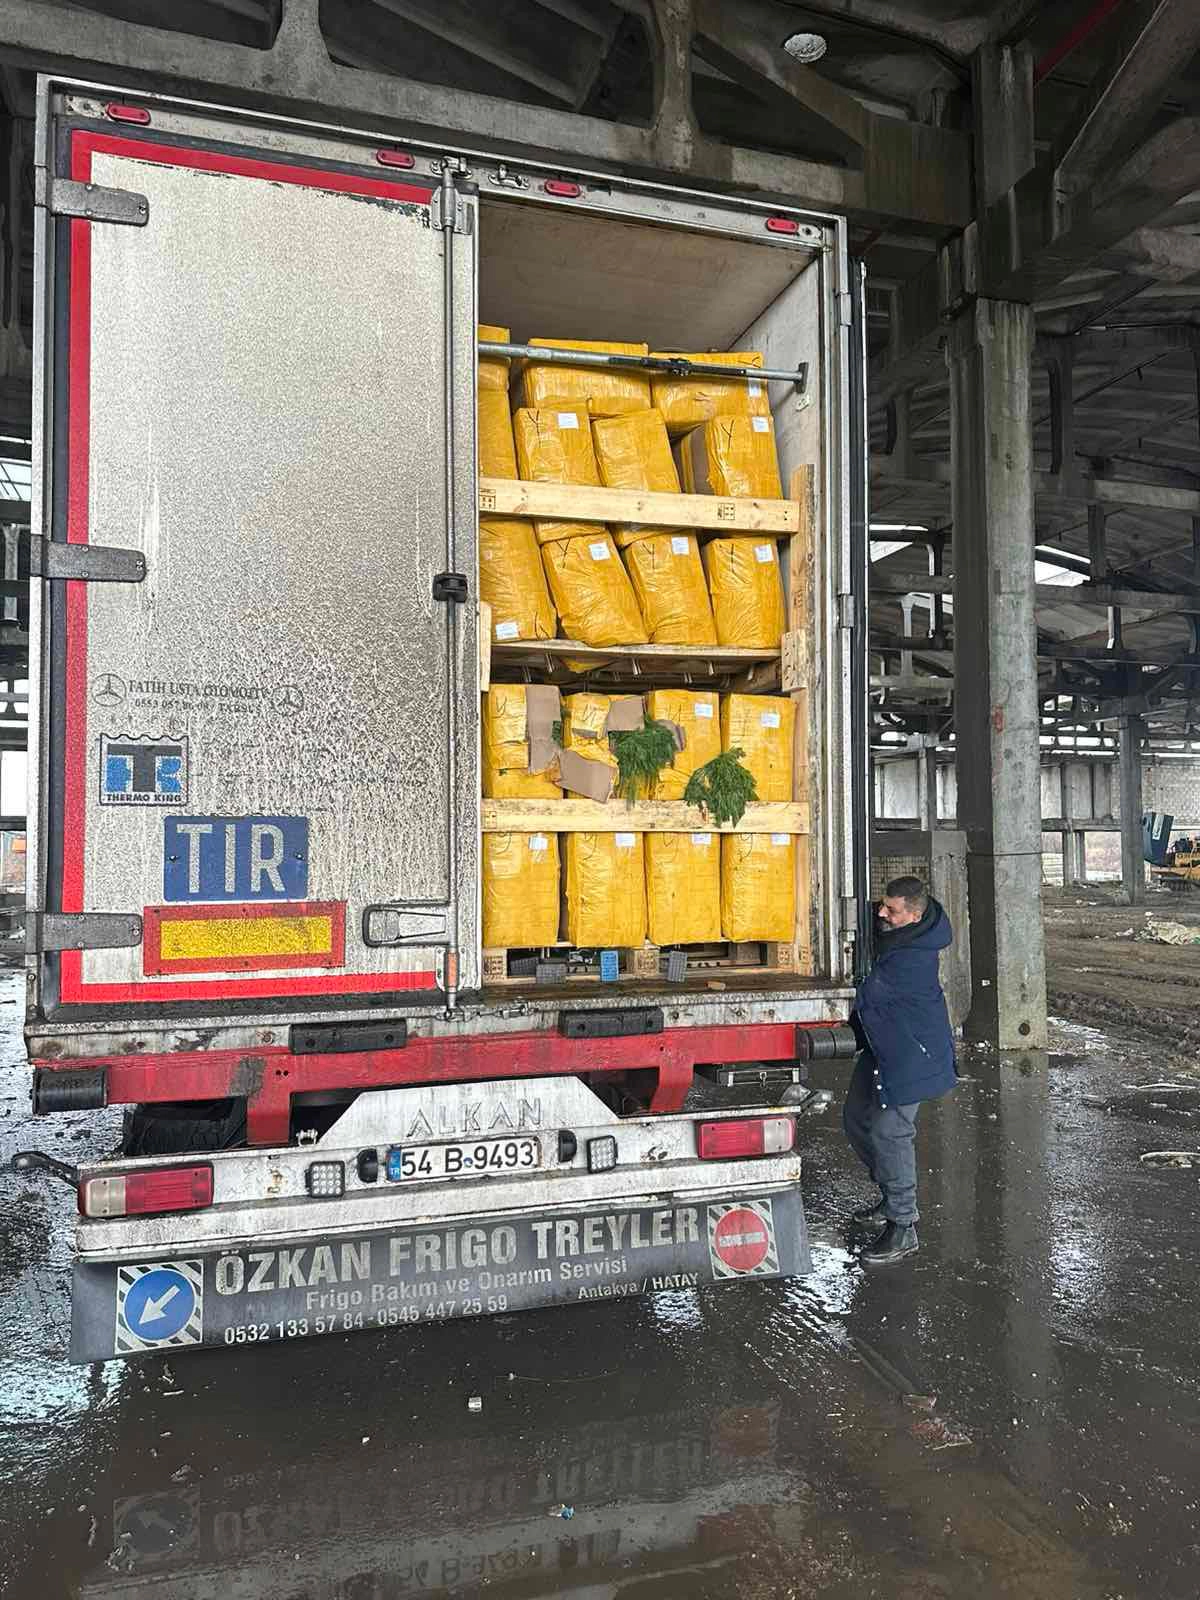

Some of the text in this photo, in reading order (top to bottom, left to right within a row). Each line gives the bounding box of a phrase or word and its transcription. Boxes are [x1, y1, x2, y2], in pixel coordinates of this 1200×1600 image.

[106, 793, 181, 803] THERMO KING
[176, 823, 286, 894] TIR
[406, 1098, 542, 1138] ALKAN
[401, 1150, 432, 1176] 54
[444, 1147, 463, 1173] B
[474, 1141, 534, 1170] 9493
[215, 1241, 371, 1296] ÖZKAN
[531, 1206, 700, 1260] TREYLER
[306, 1288, 363, 1311] Frigo
[446, 1275, 470, 1294] ve
[559, 1256, 628, 1281] Servisi
[578, 1280, 638, 1300] Antakya
[652, 1272, 699, 1290] HATAY
[224, 1322, 270, 1344] 0532
[276, 1318, 309, 1339] 133
[315, 1315, 337, 1333] 57
[343, 1311, 364, 1330] 84
[377, 1305, 420, 1326] 0545
[425, 1300, 456, 1319] 447
[462, 1297, 482, 1316] 25
[487, 1294, 508, 1313] 59
